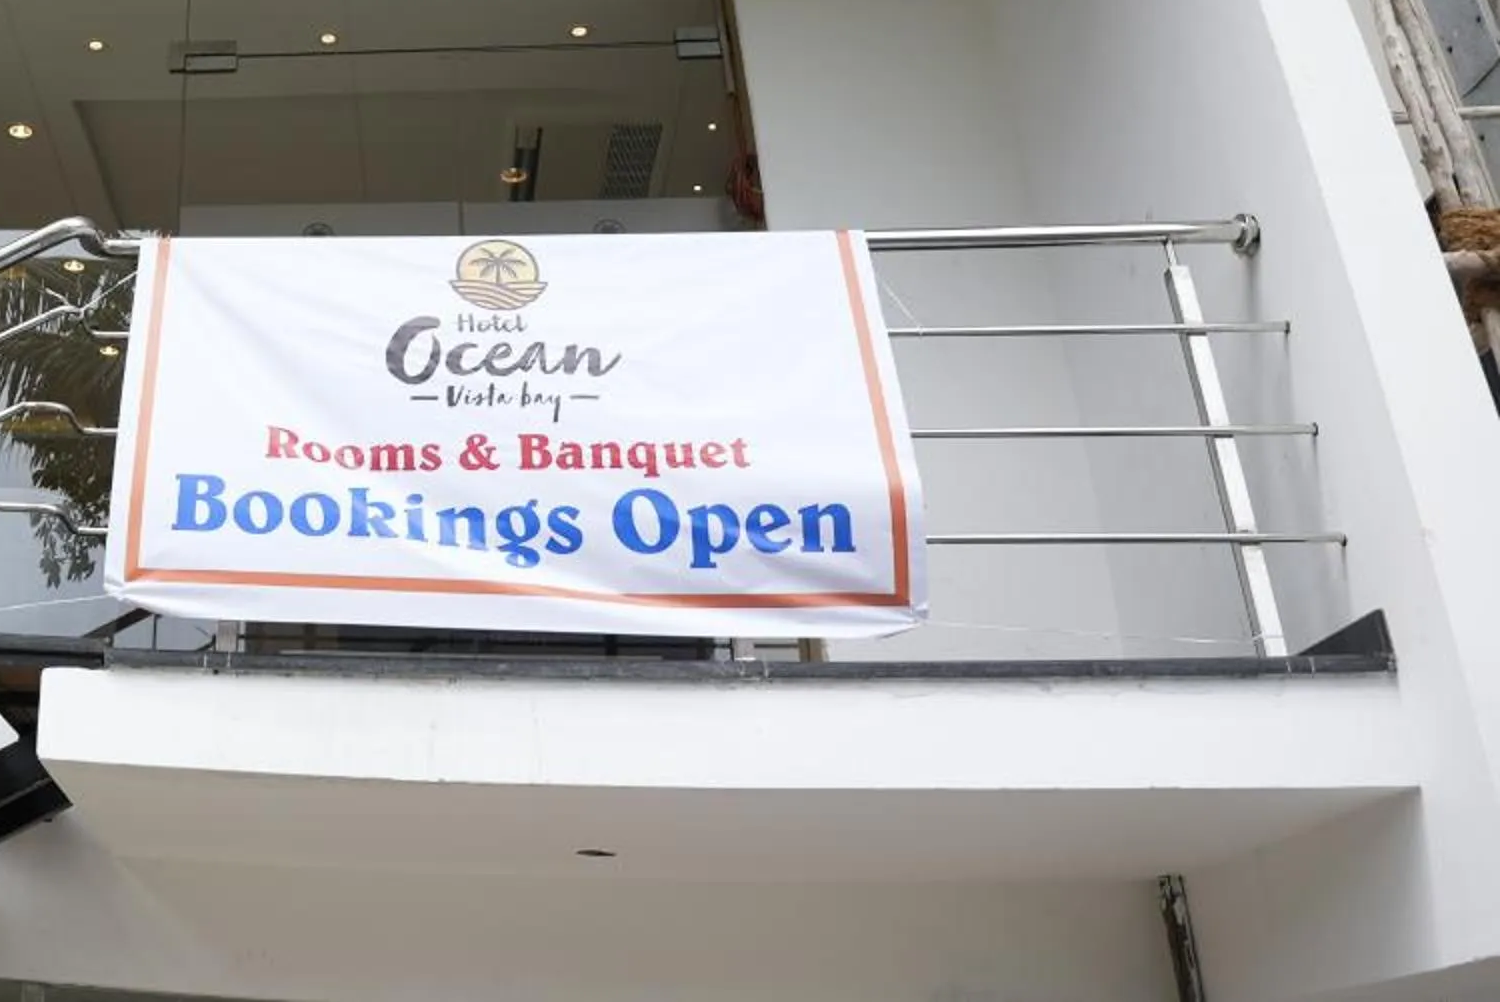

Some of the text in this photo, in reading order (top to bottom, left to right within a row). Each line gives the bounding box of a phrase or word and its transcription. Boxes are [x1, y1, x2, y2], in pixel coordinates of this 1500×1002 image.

[456, 313, 528, 333] Hotel
[385, 315, 622, 385] Ocean
[446, 380, 562, 423] Vista bay
[264, 425, 750, 478] Rooms & Banquet
[171, 473, 857, 569] Bookings Open
